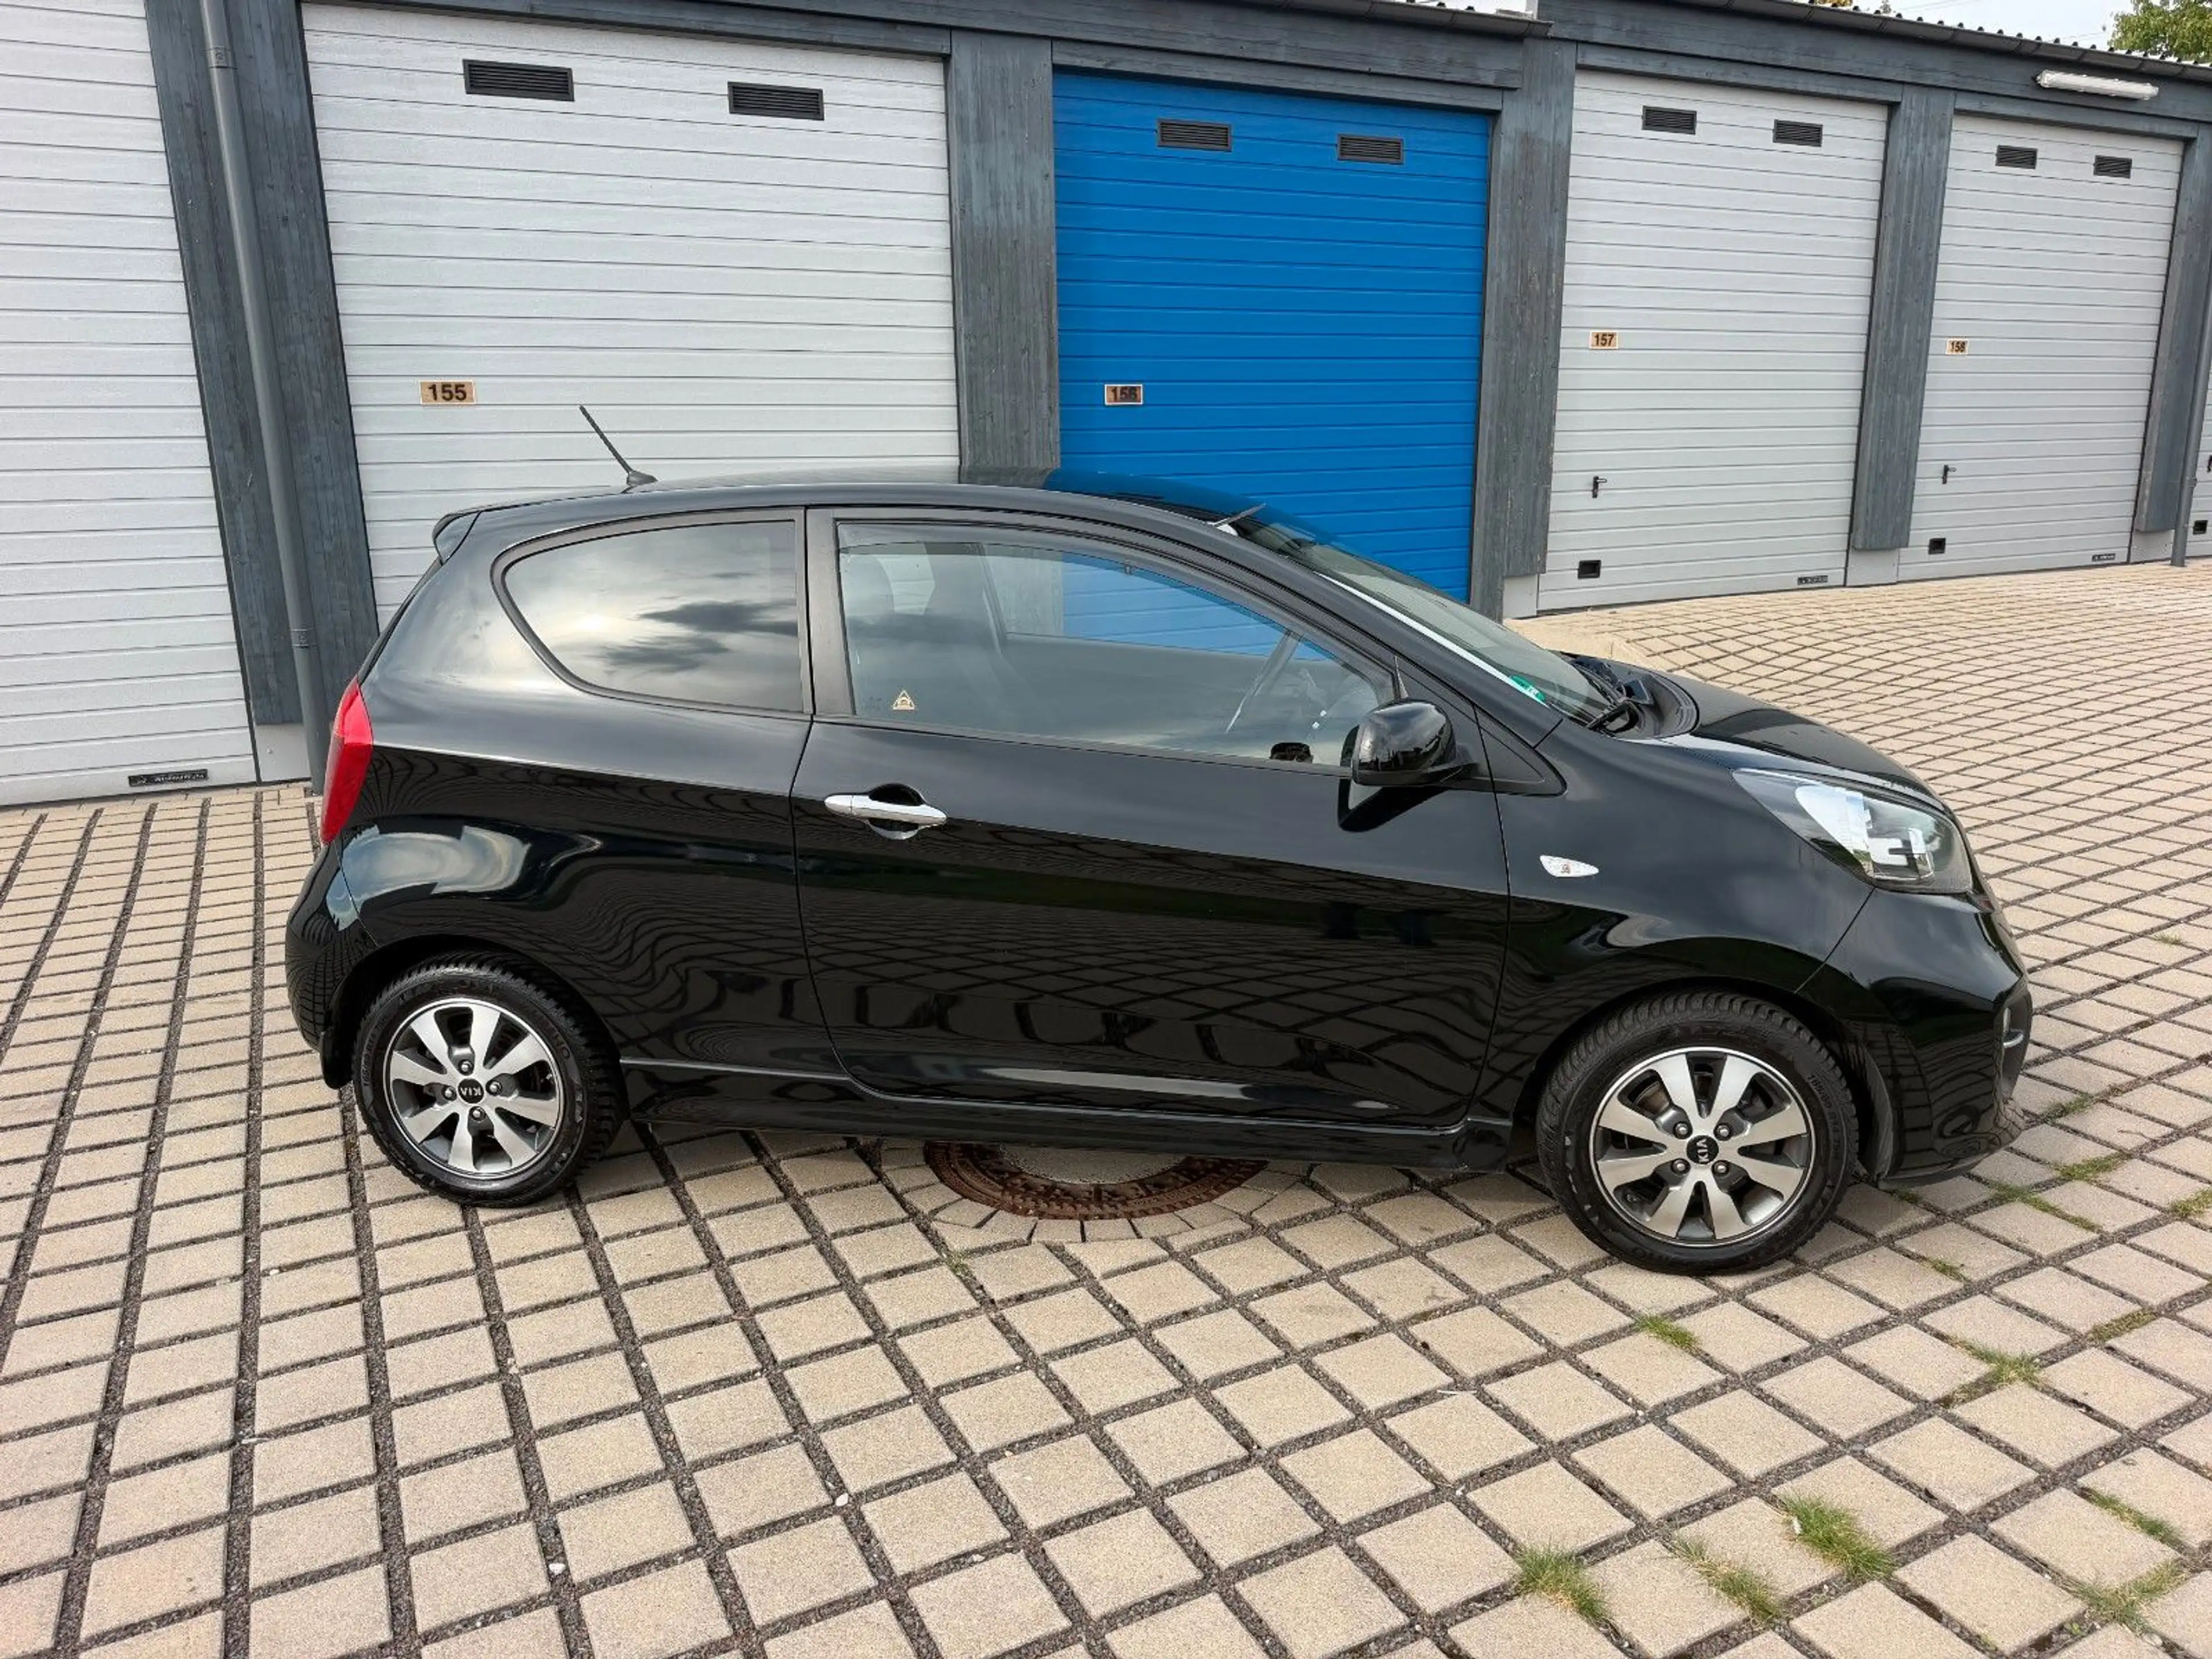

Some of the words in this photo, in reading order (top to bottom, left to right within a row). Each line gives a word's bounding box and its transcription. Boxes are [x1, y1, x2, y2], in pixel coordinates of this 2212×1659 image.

[1594, 333, 1614, 346] 157
[429, 384, 467, 401] 155
[460, 1086, 482, 1096] KIA
[1696, 1138, 1709, 1162] KIA
